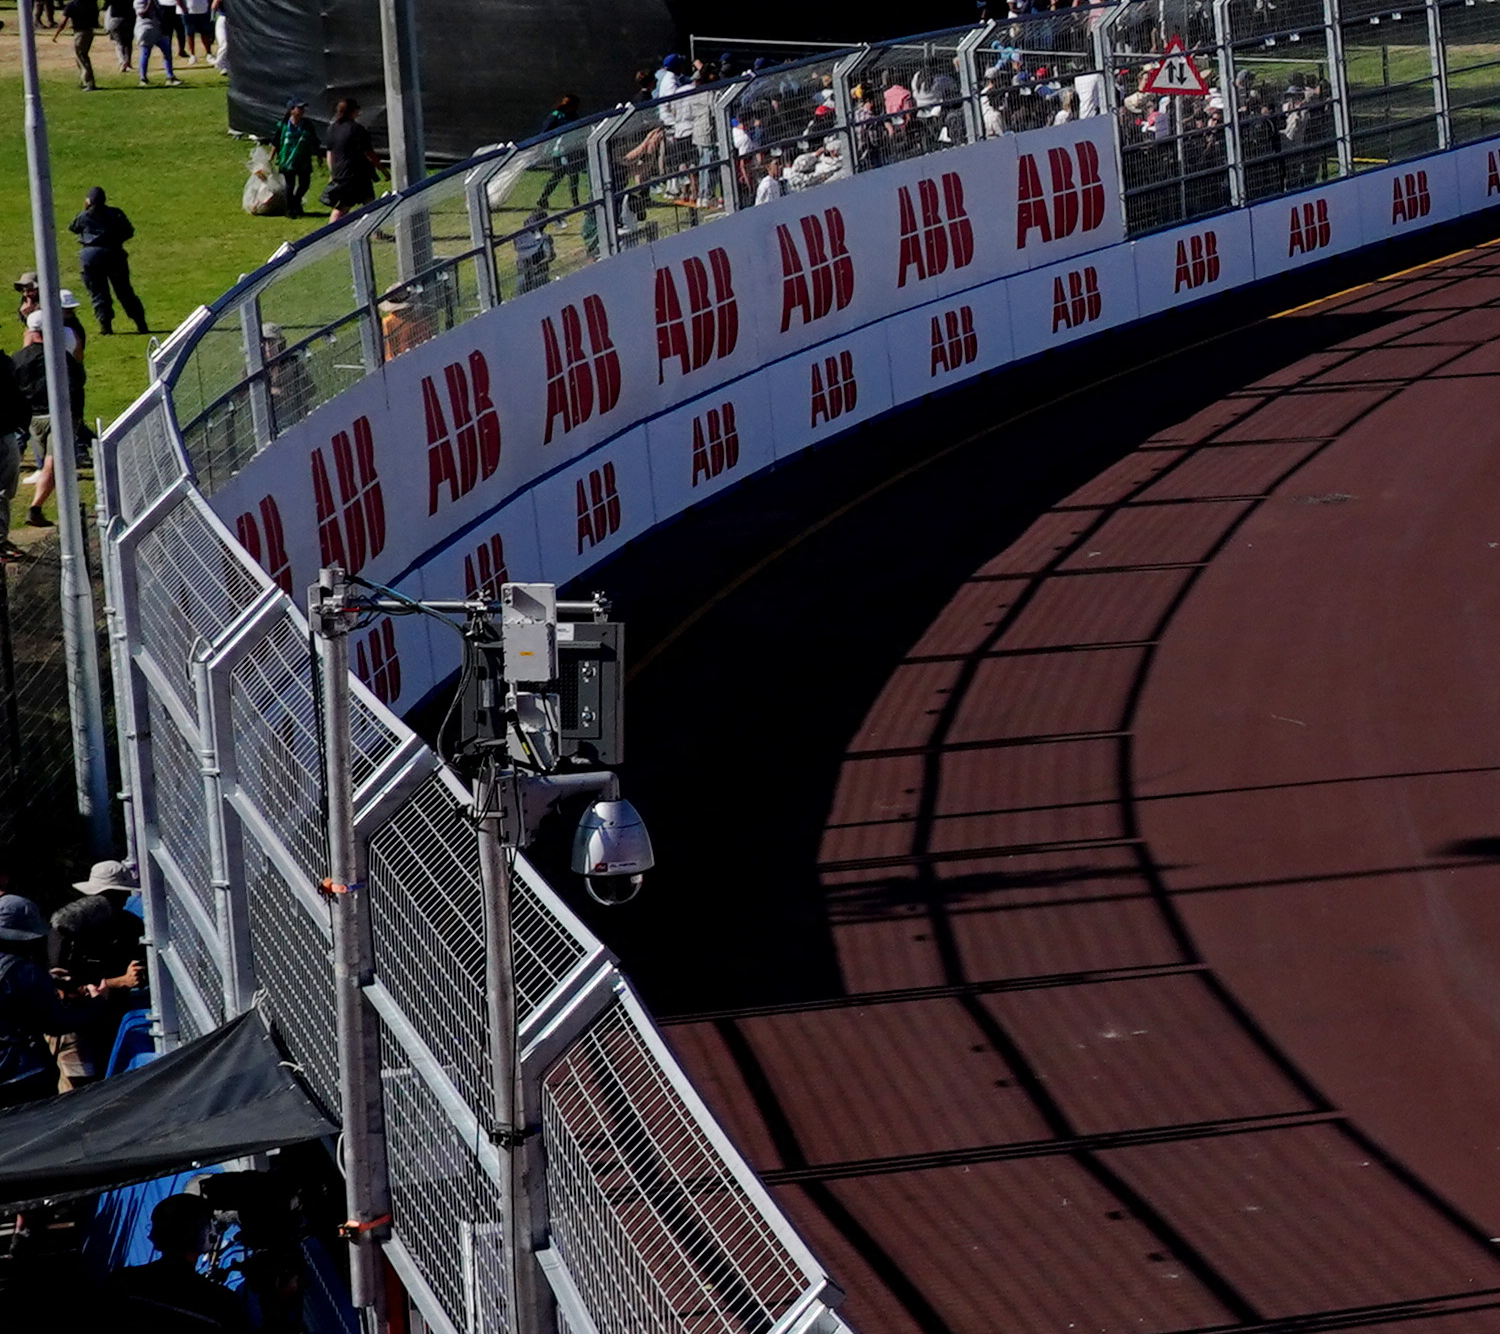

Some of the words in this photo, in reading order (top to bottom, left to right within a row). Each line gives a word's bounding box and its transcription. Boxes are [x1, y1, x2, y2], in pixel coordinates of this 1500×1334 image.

[897, 171, 974, 289] ABB
[1016, 140, 1105, 250] ABB
[1288, 197, 1332, 258] ABB
[1391, 169, 1431, 223] ABB
[777, 206, 855, 333] ABB
[1052, 265, 1102, 335] ABB
[1174, 230, 1221, 295] ABB
[653, 246, 740, 385] ABB
[931, 304, 978, 378] ABB
[543, 293, 622, 445] ABB
[811, 349, 858, 429] ABB
[421, 348, 502, 517] ABB
[692, 401, 740, 489] ABB
[311, 414, 386, 577] ABB
[576, 460, 622, 556] ABB
